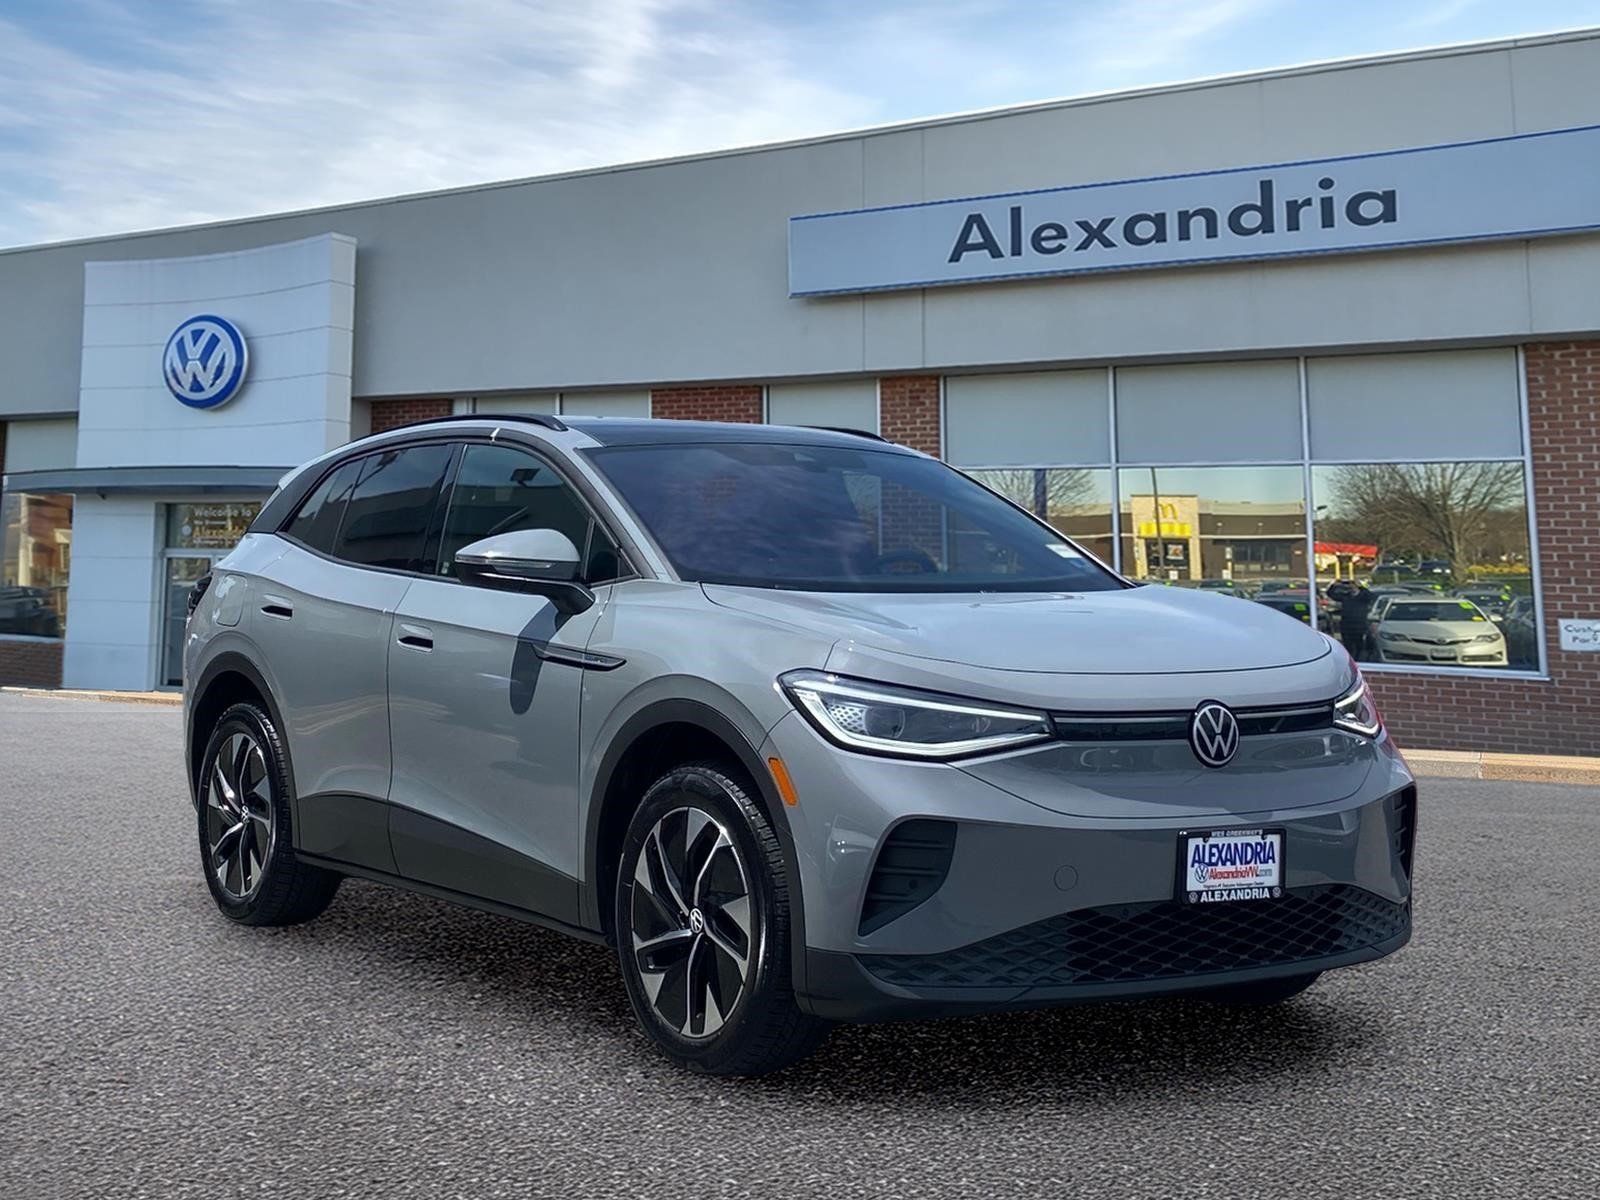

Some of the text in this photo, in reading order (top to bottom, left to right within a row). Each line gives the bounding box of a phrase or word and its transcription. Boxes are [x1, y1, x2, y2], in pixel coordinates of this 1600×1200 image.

[948, 177, 1397, 263] Alexandria
[166, 318, 243, 403] VW
[1194, 705, 1238, 764] VW
[1191, 841, 1276, 868] ALEXANDRIA
[1200, 888, 1271, 903] ALEXANDRIA
